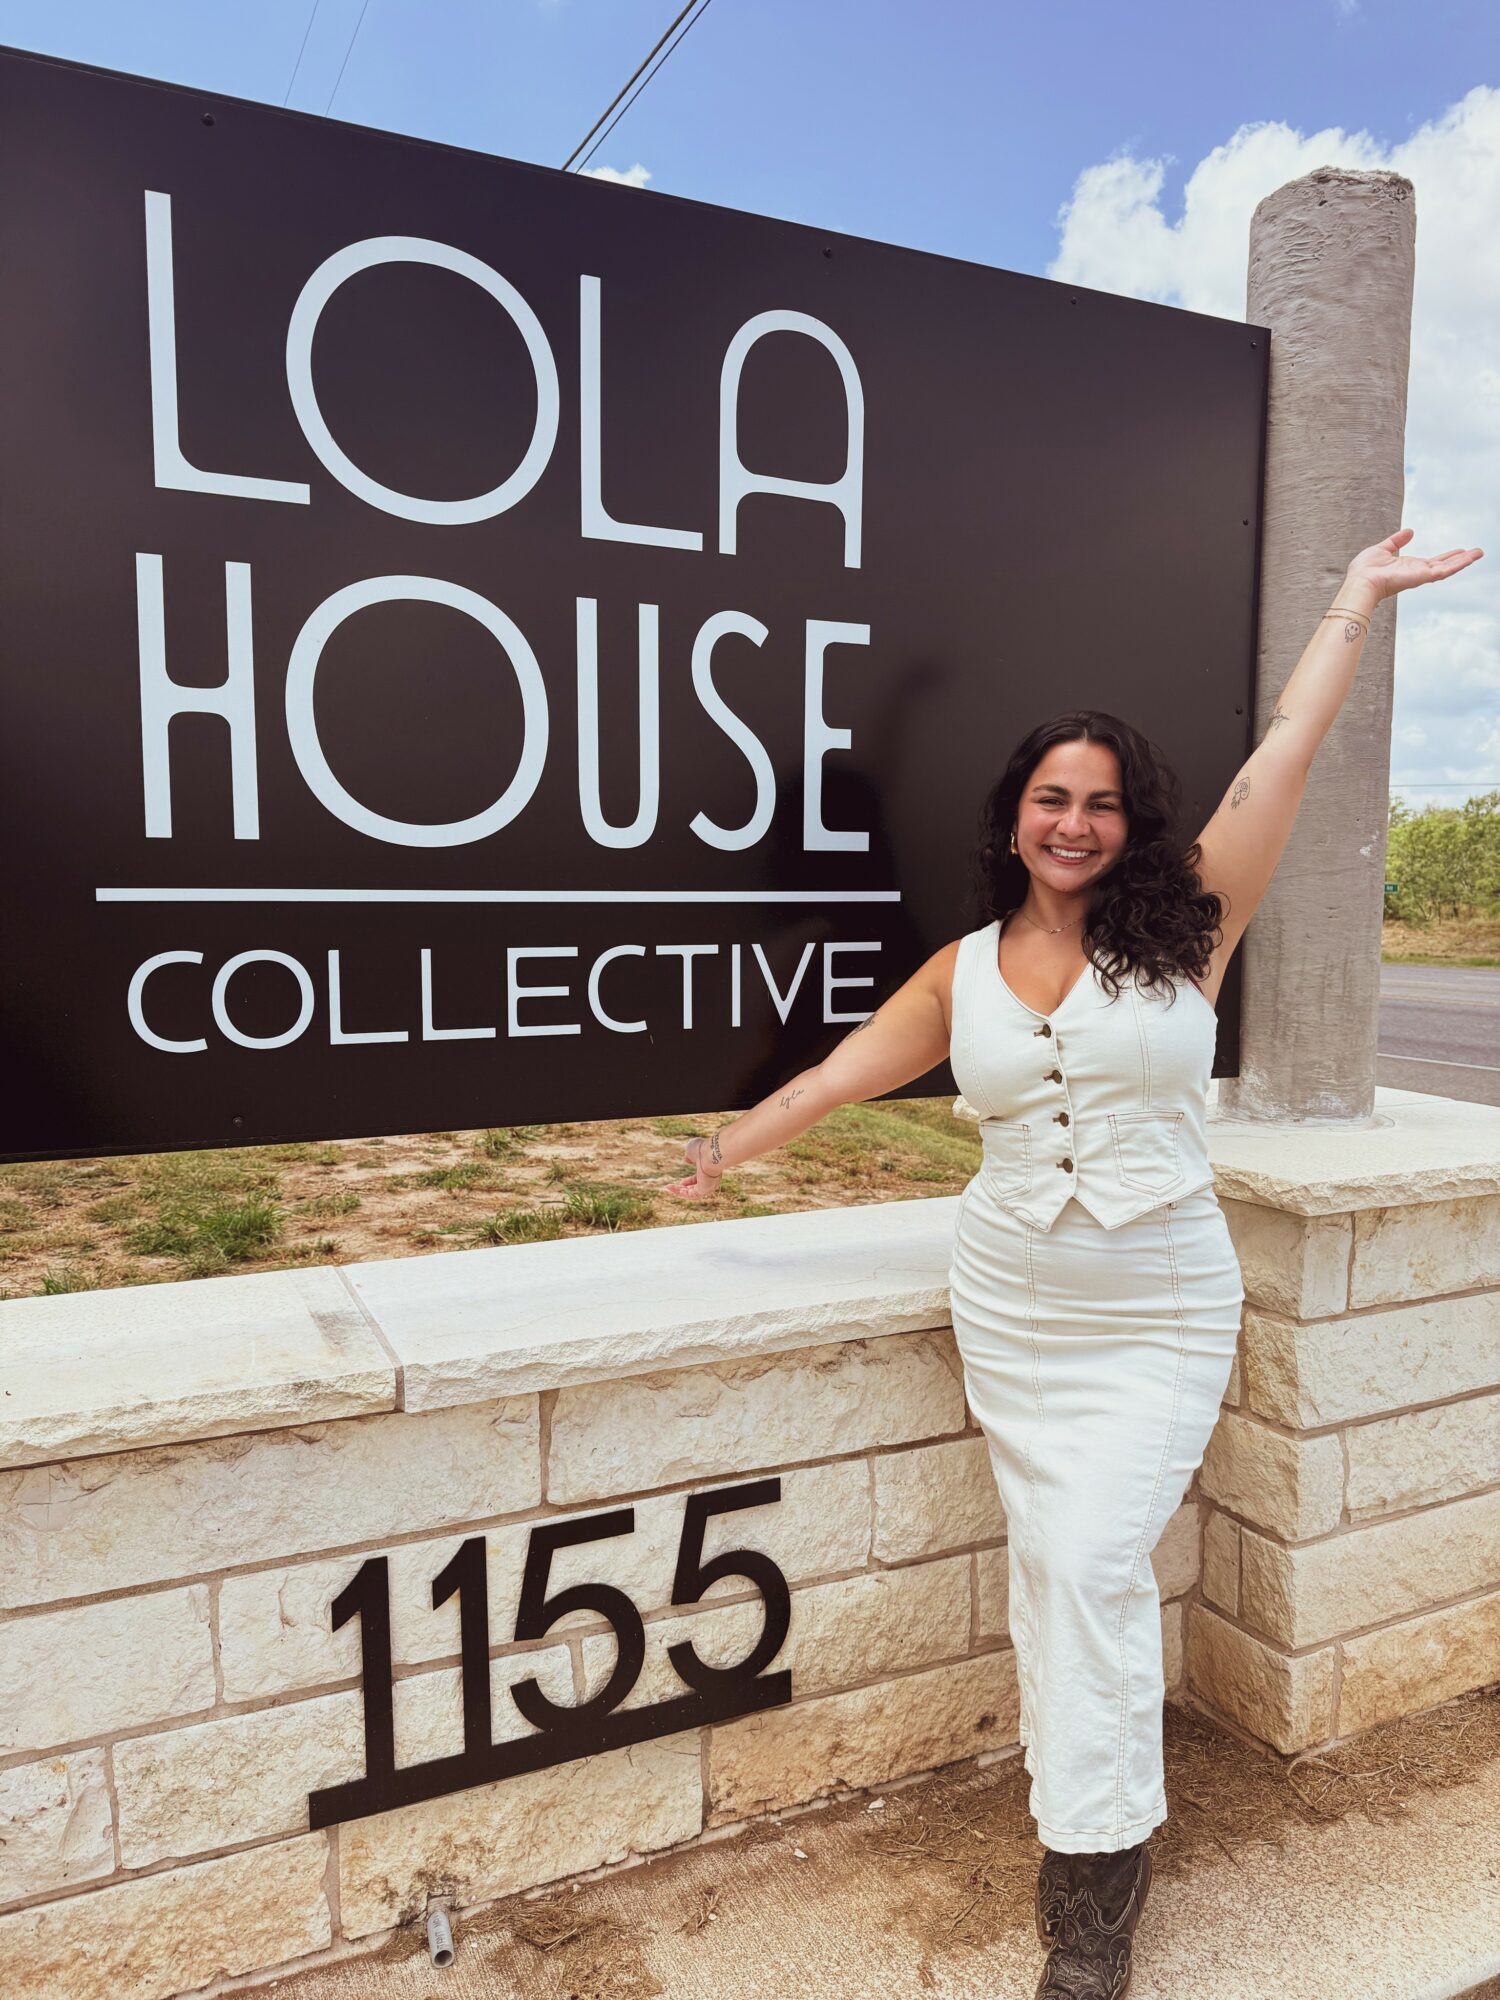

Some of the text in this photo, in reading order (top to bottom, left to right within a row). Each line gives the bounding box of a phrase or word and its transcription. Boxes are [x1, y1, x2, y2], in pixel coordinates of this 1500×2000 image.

[144, 190, 865, 569] LOLA
[135, 552, 871, 852] HOUSE
[127, 941, 882, 1054] COLLECTIVE
[331, 1477, 792, 1788] 1155
